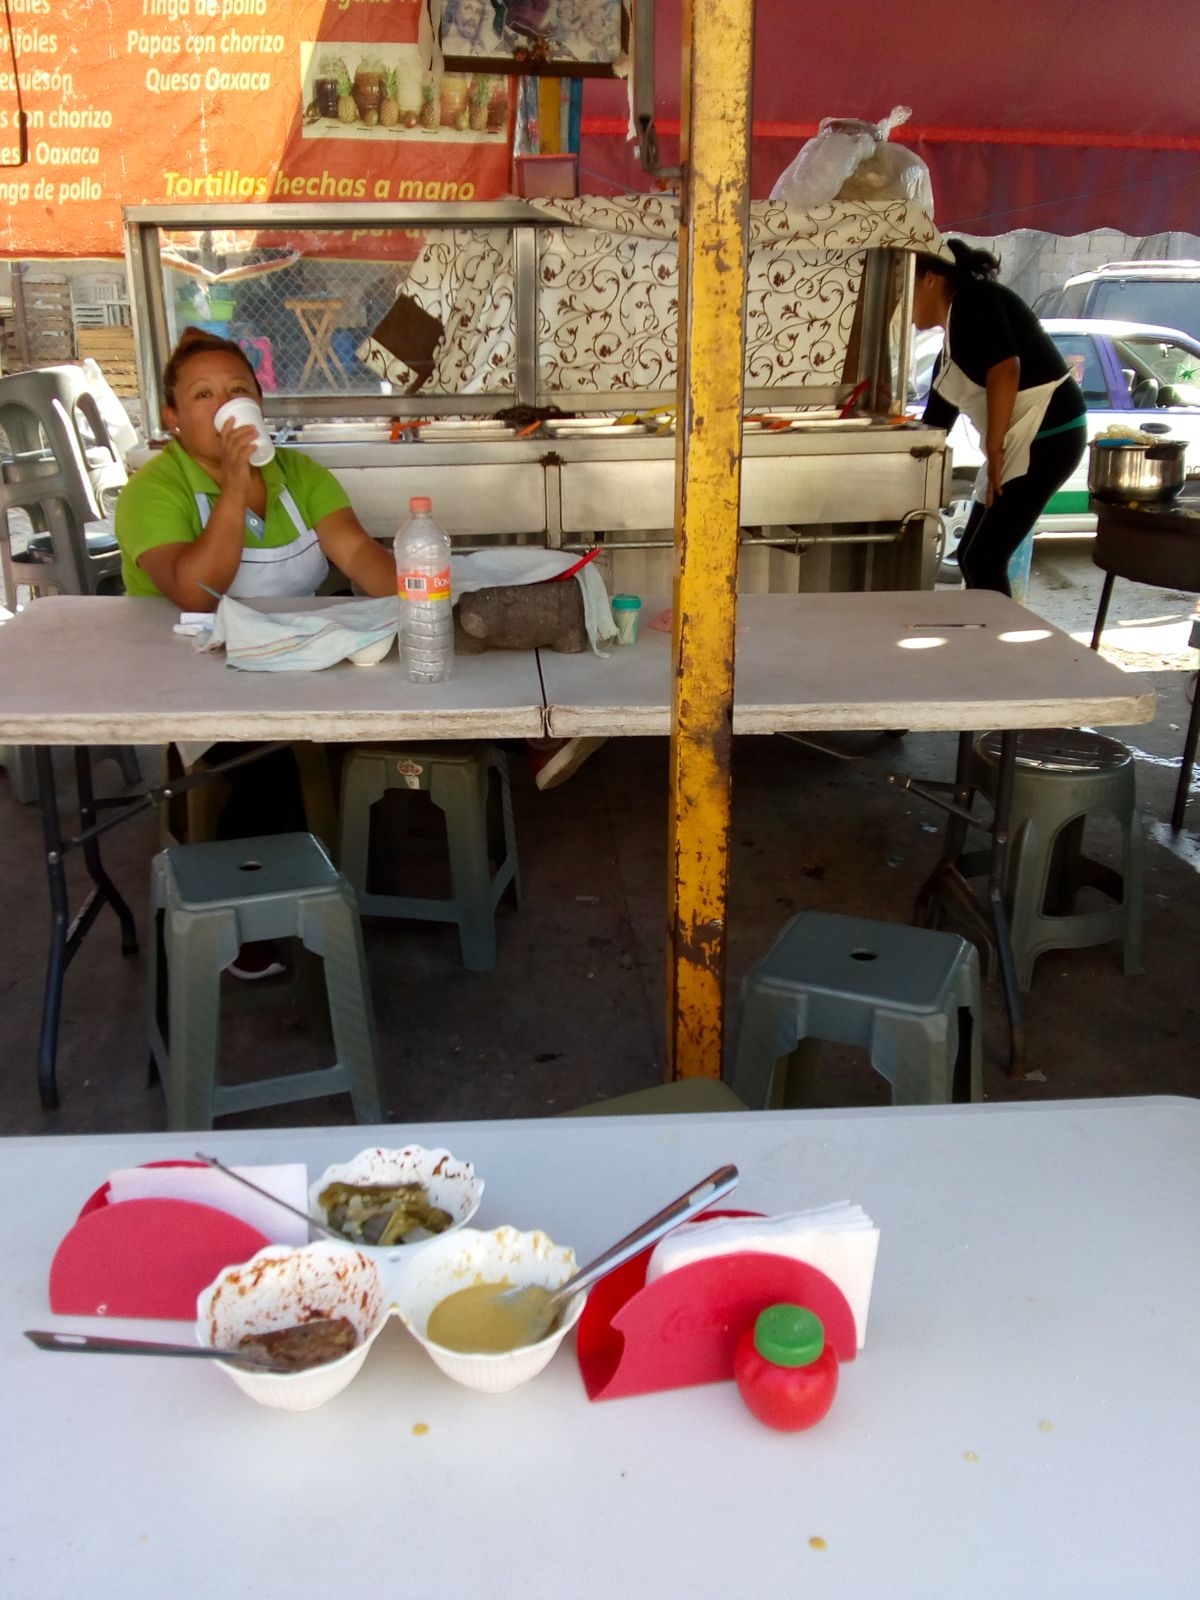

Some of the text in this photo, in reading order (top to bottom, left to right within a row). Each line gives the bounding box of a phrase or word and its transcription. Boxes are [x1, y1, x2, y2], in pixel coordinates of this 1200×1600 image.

[127, 28, 284, 59] Papas con chorizo
[146, 67, 271, 94] Queso Oaxaca
[49, 103, 113, 128] chorizo
[35, 141, 100, 165] Oaxaca
[34, 176, 54, 200] de
[58, 176, 102, 205] pollo
[163, 170, 475, 201] Tortillas hechas a mano
